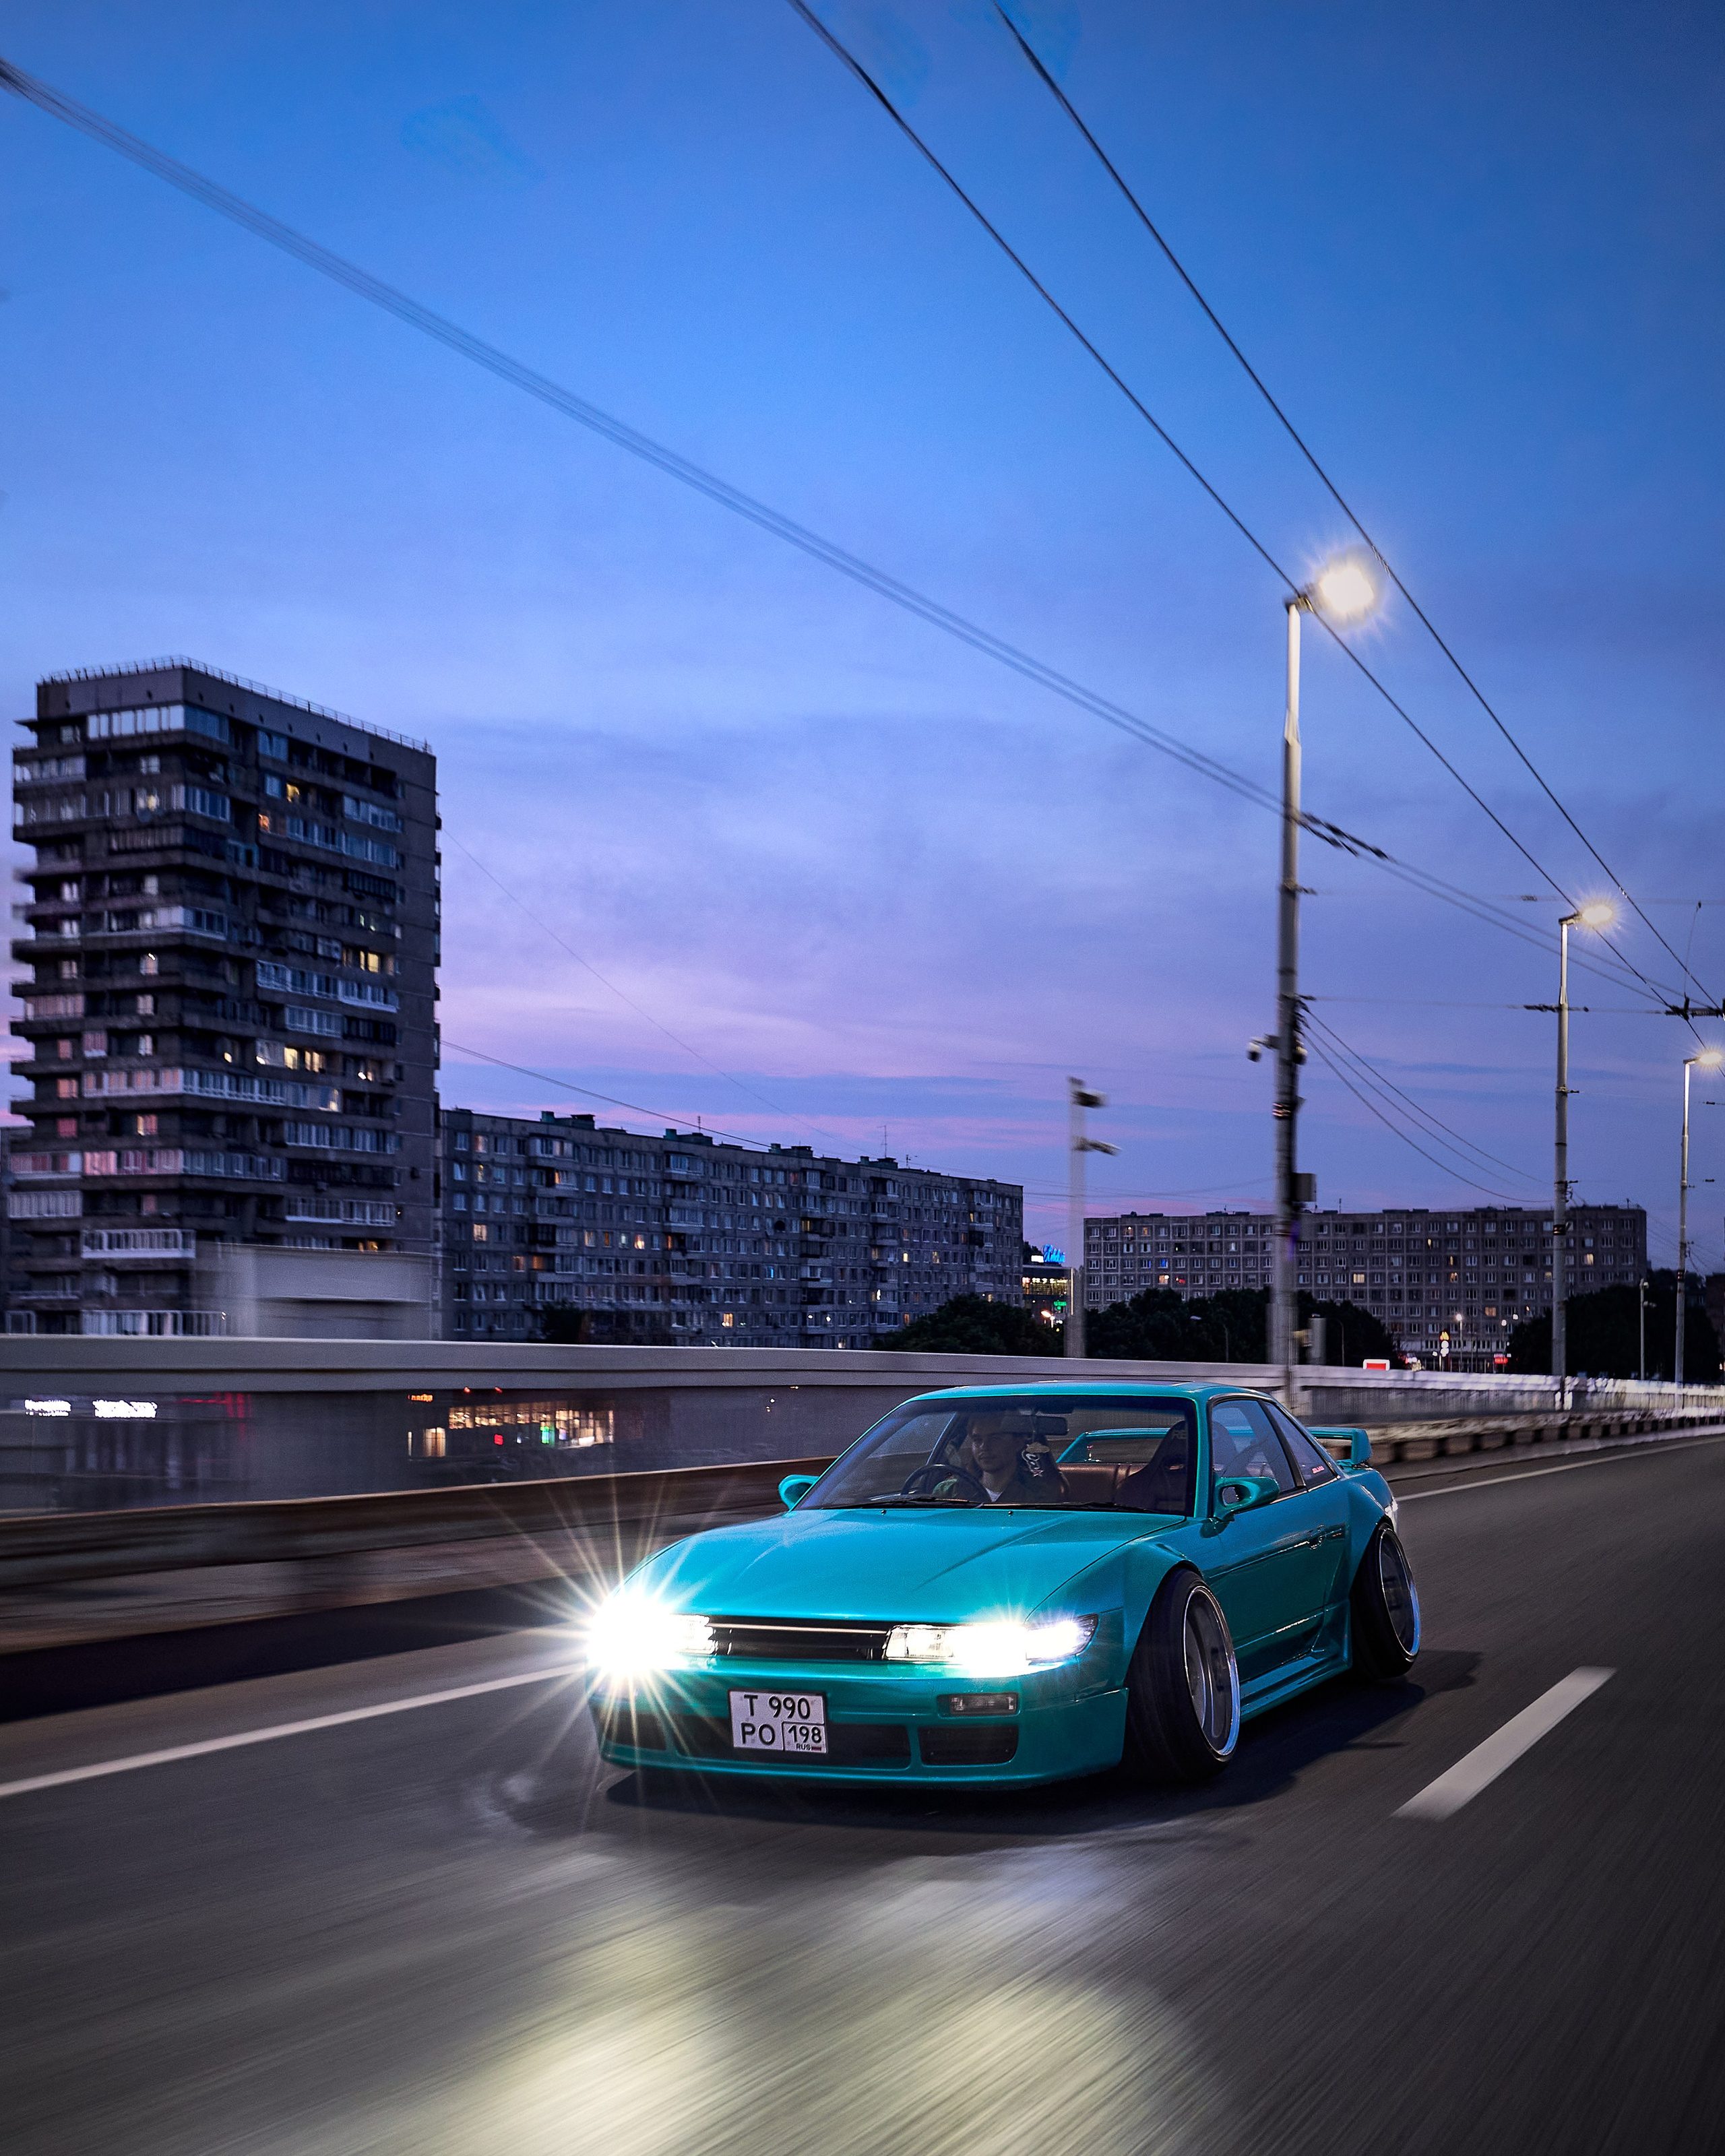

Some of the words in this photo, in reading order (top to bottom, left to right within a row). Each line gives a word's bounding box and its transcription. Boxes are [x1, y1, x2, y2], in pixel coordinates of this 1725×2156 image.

[744, 1694, 758, 1716] T
[768, 1696, 810, 1719] 990
[741, 1722, 775, 1745] PO
[788, 1725, 821, 1743] 198
